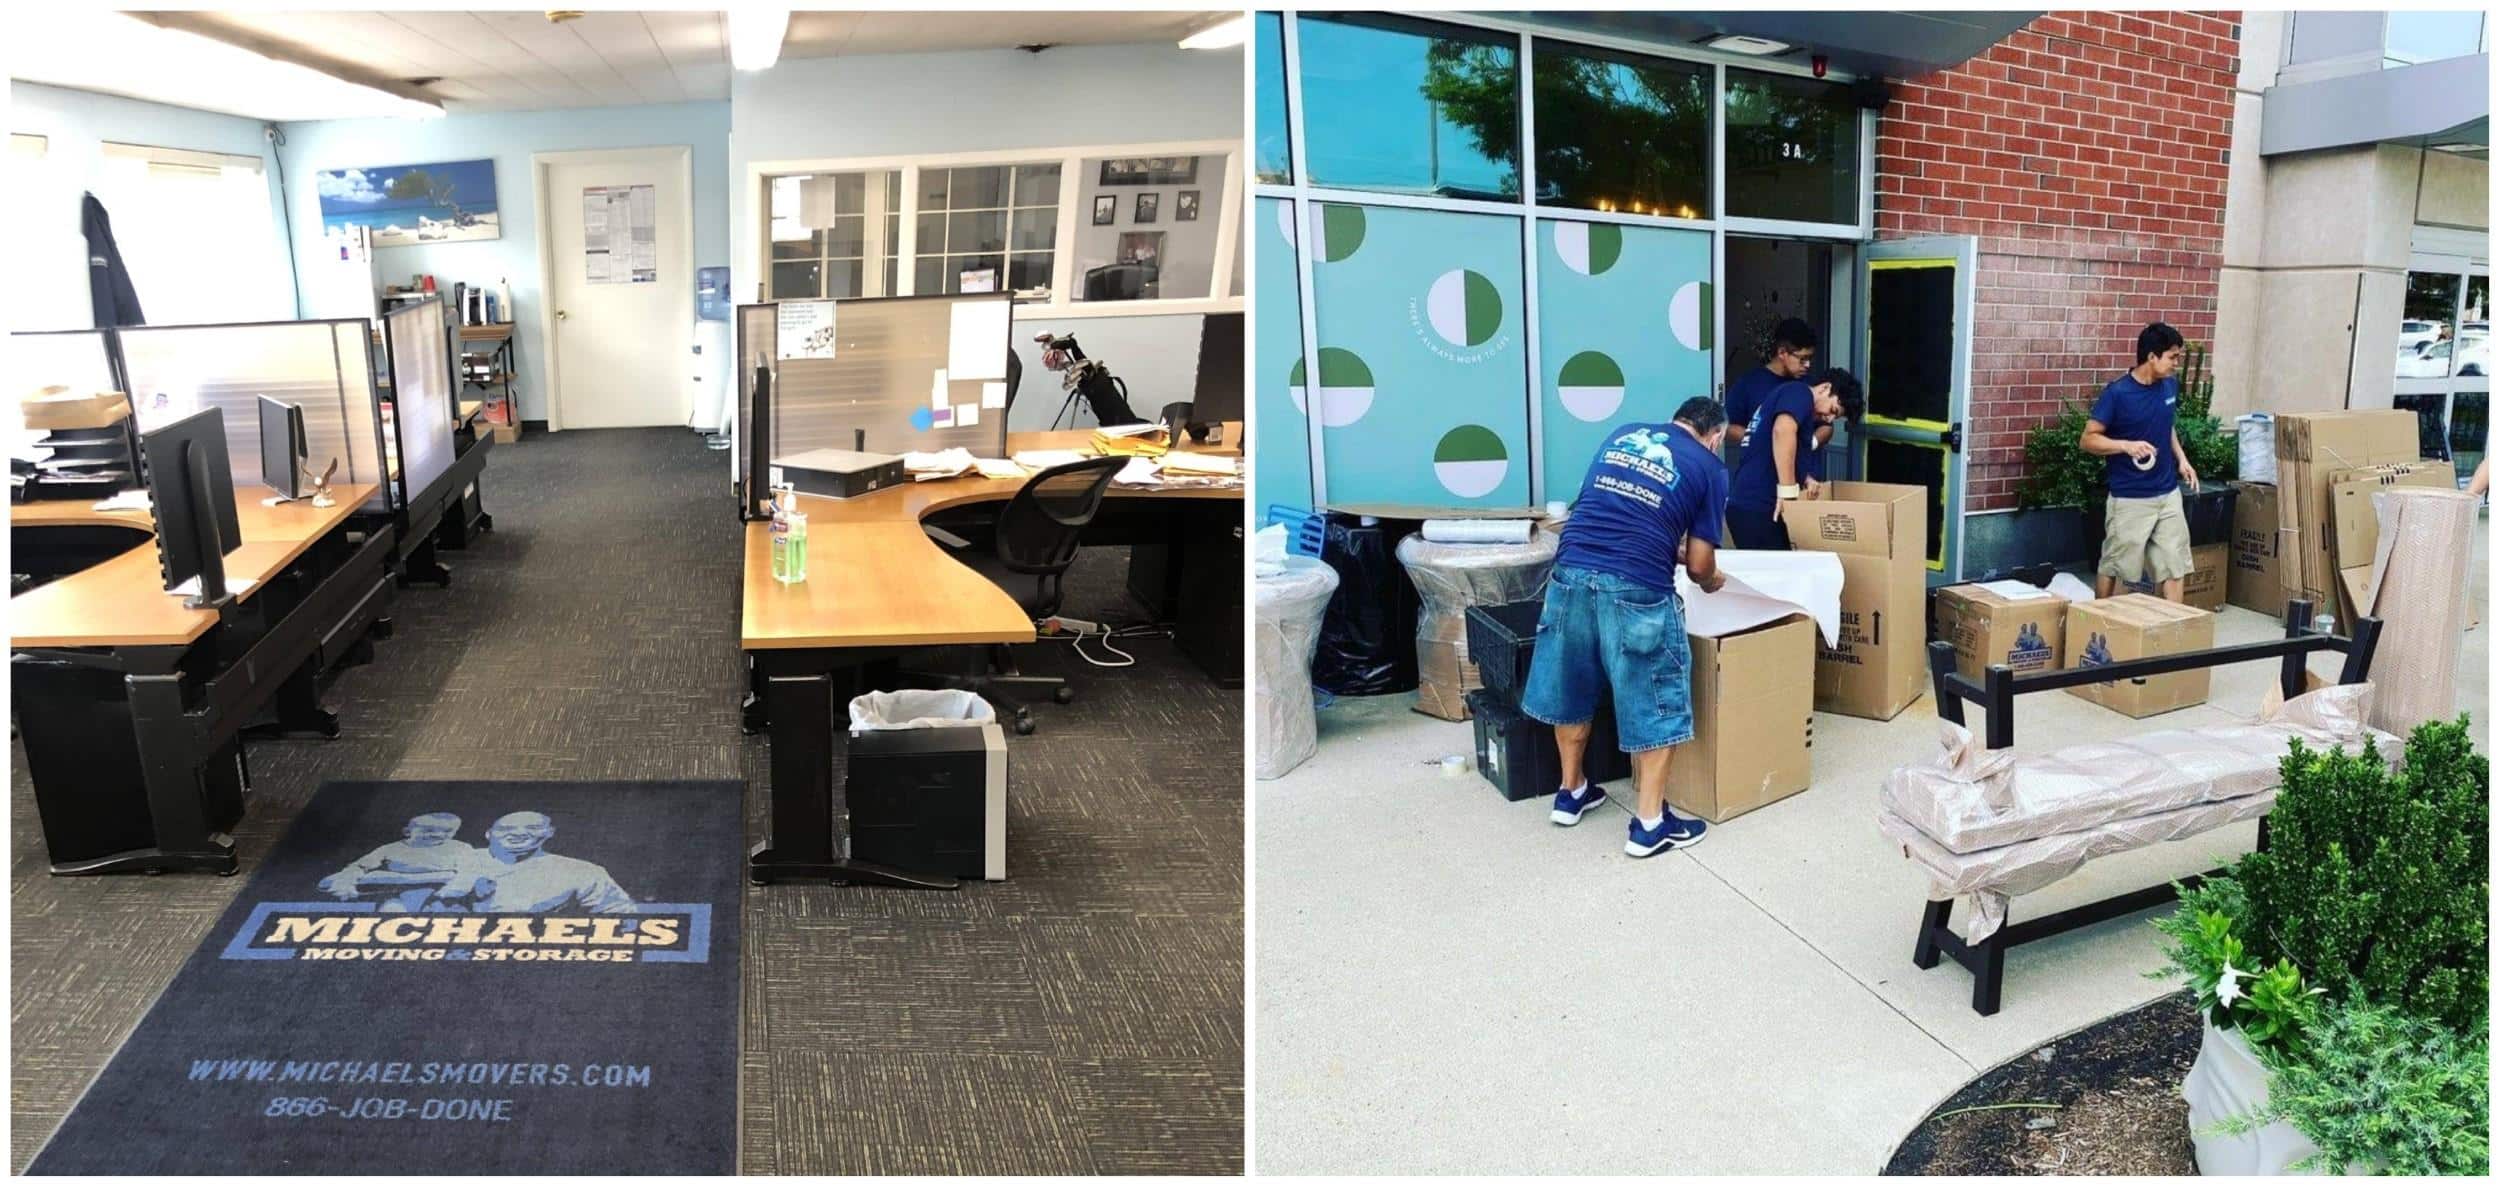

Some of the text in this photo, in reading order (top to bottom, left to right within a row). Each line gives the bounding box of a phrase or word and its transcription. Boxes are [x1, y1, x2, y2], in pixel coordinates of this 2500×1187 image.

[1782, 142, 1801, 159] 3 A
[1840, 611, 1860, 625] GILE
[1818, 650, 1863, 665] BARREL
[187, 1059, 652, 1088] WWW.MICHAELSMOVERS.COM
[263, 1096, 514, 1122] 866-JOB-DONE
